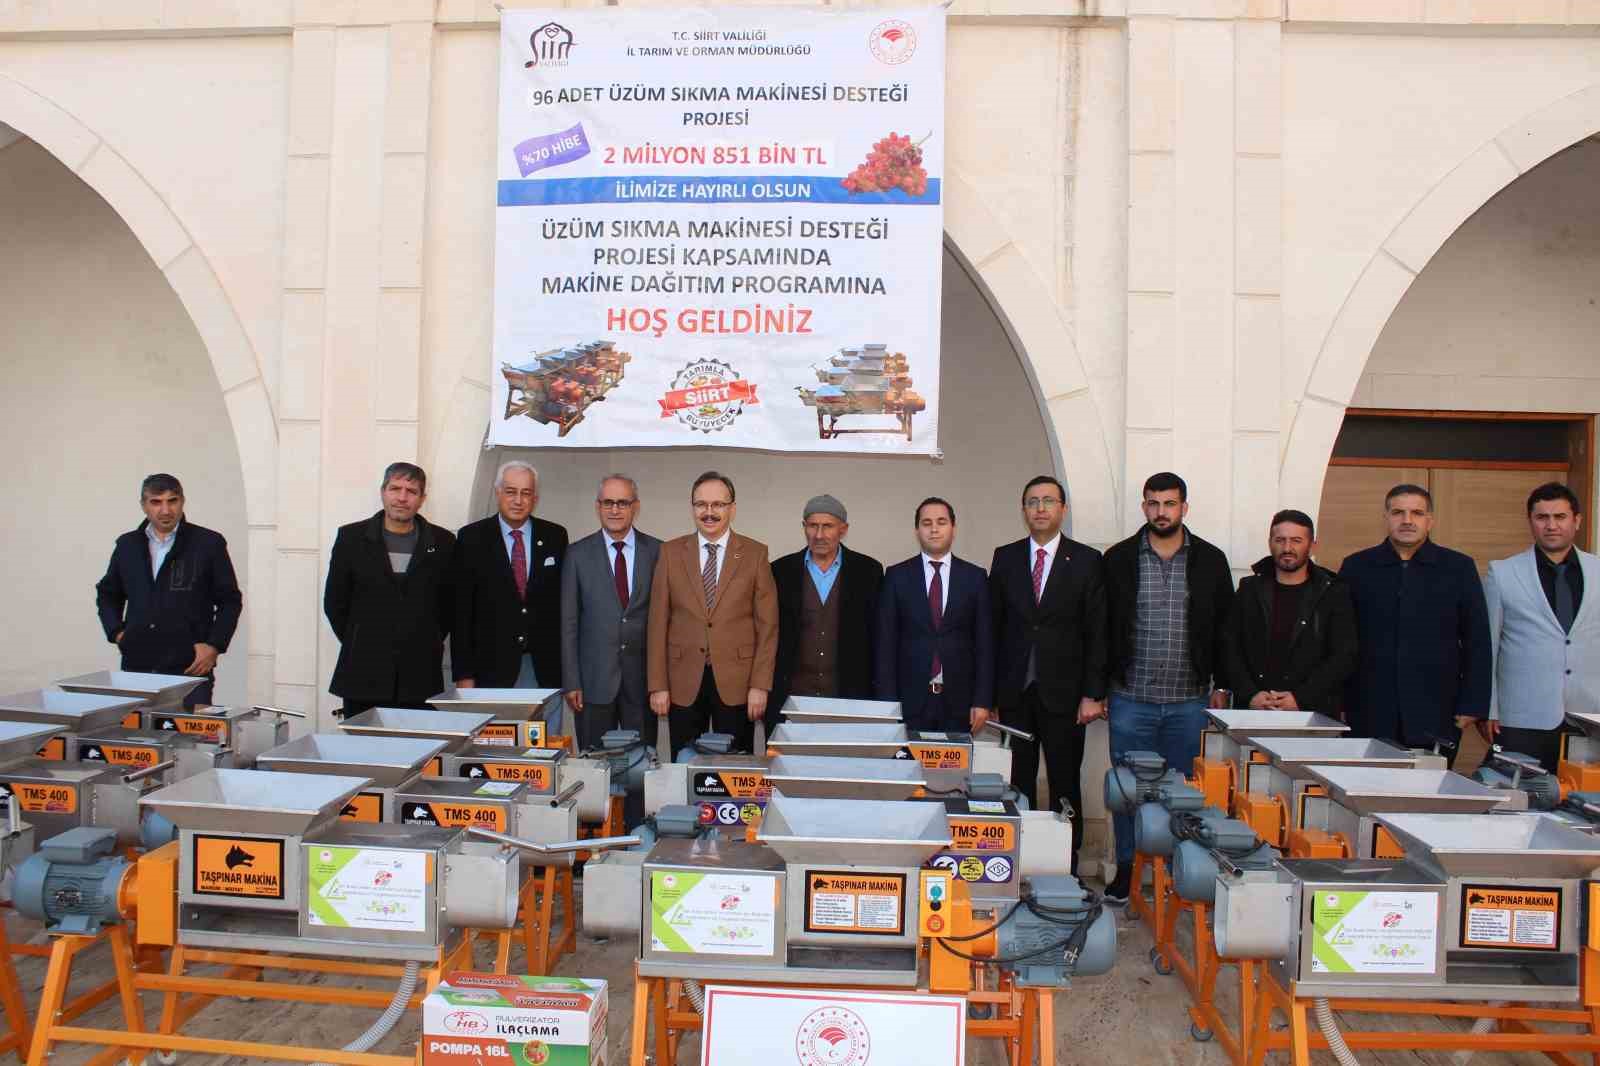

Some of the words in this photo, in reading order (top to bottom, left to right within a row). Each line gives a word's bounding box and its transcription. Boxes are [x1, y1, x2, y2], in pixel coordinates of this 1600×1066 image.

[672, 31, 690, 41] T.C.
[627, 45, 636, 56] İL
[639, 47, 672, 56] TARIM
[675, 47, 689, 56] VE
[692, 47, 735, 56] ORMAN
[738, 44, 811, 56] MÜDÜRLÜĞÜ
[533, 90, 553, 105] 96
[557, 86, 604, 103] ADET
[609, 83, 665, 101] ÜZÜM
[671, 86, 730, 101] SIKMA
[736, 82, 828, 101] MAKİNESİ
[833, 84, 908, 102] DESTEĞİ
[682, 109, 750, 126] PROJESİ
[521, 147, 550, 167] %70
[551, 134, 583, 154] HİBE
[603, 147, 615, 164] 2
[623, 142, 706, 165] MİLYON
[712, 146, 751, 164] 851
[758, 142, 796, 164] BİN
[802, 147, 827, 165] TL
[615, 180, 677, 199] İLİMİZE
[682, 183, 746, 198] HAYIRLI
[751, 183, 811, 198] OLSUN
[541, 217, 604, 239] ÜZÜM
[611, 220, 681, 238] SIKMA
[688, 216, 792, 238] MAKİNESİ
[799, 217, 888, 239] DESTEĞİ
[593, 243, 675, 265] PROJESİ
[683, 247, 832, 266] KAPSAMINDA
[542, 271, 624, 294] MAKİNE
[631, 270, 724, 294] DAĞITIM
[731, 275, 887, 295] PROGRAMINA
[607, 307, 668, 338] HOŞ
[677, 303, 813, 334] GELDİNİZ
[184, 721, 204, 732] TMS
[111, 749, 133, 760] TMS
[134, 751, 152, 762] 400
[920, 750, 941, 760] TMS
[943, 751, 961, 761] 400
[496, 768, 520, 779] TMS
[523, 769, 542, 780] 400
[732, 776, 756, 787] TMS
[23, 788, 47, 800] TMS
[49, 789, 69, 801] 400
[444, 808, 472, 821] TMS
[474, 809, 497, 822] 400
[950, 825, 978, 837] TMS
[982, 826, 1005, 838] 400
[200, 870, 242, 885] TAŞPINAR
[244, 872, 278, 886] MAKİNA
[831, 879, 867, 891] TAŞPINAR
[868, 879, 898, 892] MAKİNA
[1525, 895, 1554, 906] MAKİNA
[456, 1021, 480, 1029] HB
[429, 1041, 483, 1056] POMPA
[485, 1045, 510, 1058] 16L
